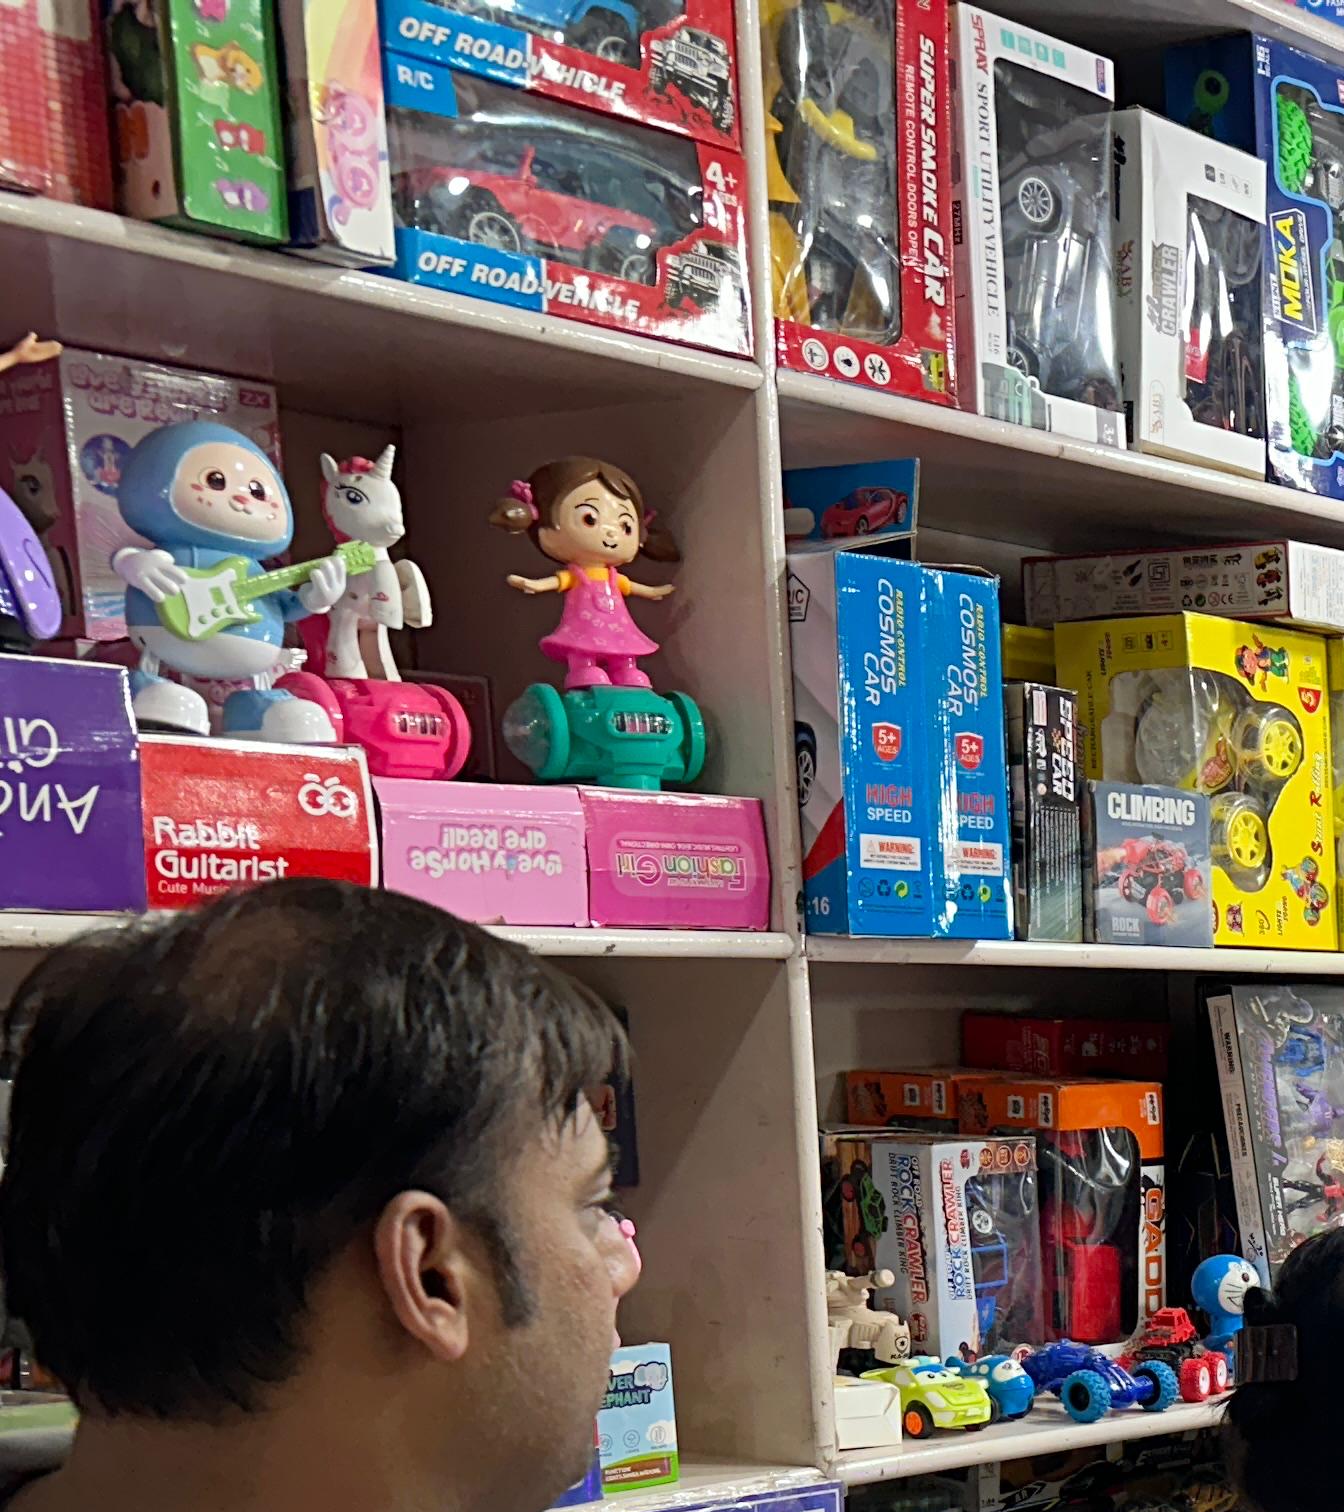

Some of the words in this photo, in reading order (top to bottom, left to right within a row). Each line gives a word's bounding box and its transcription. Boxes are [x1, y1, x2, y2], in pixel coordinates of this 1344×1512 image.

[399, 17, 451, 46] OFF
[970, 14, 989, 77] SPRAY
[397, 65, 435, 91] R/C
[905, 64, 915, 115] REMOTE
[919, 34, 936, 127] SUPER
[977, 82, 991, 143] SPORT
[905, 117, 917, 182] CONTROL
[921, 125, 937, 224] SMOKE
[705, 161, 738, 191] 4+
[980, 150, 994, 230] UTILITY
[907, 183, 919, 229] DOORS
[418, 252, 467, 278] OFF
[924, 228, 945, 307] CAR
[984, 233, 999, 318] VEHICLE
[1161, 245, 1180, 336] CRAWLER
[1275, 215, 1303, 321] MOKA
[878, 578, 897, 695] COSMOS
[959, 593, 979, 706] COSMOS
[864, 651, 880, 706] CAR
[947, 664, 964, 717] CAR
[0, 717, 59, 774] Gi
[878, 728, 897, 745] 5+
[960, 738, 979, 753] 5+
[1059, 696, 1075, 802] SPEED
[866, 783, 912, 807] HIGH
[1051, 752, 1064, 798] CAR
[153, 815, 260, 850] Rabbit
[867, 807, 912, 824] SPEED
[1106, 791, 1196, 827] CLIMBING
[155, 850, 289, 881] Guitarist
[157, 880, 188, 893] Cute
[615, 852, 663, 887] Girl
[663, 854, 747, 892] Fashion
[806, 897, 831, 916] :16
[1111, 915, 1141, 933] ROCK
[898, 1155, 915, 1213] ROCK
[941, 1158, 960, 1245] CRAWLER
[902, 1211, 928, 1305] CRAWLER
[951, 1248, 966, 1299] ROCK
[602, 1388, 651, 1408] EPHANT
[608, 1375, 633, 1391] VER
